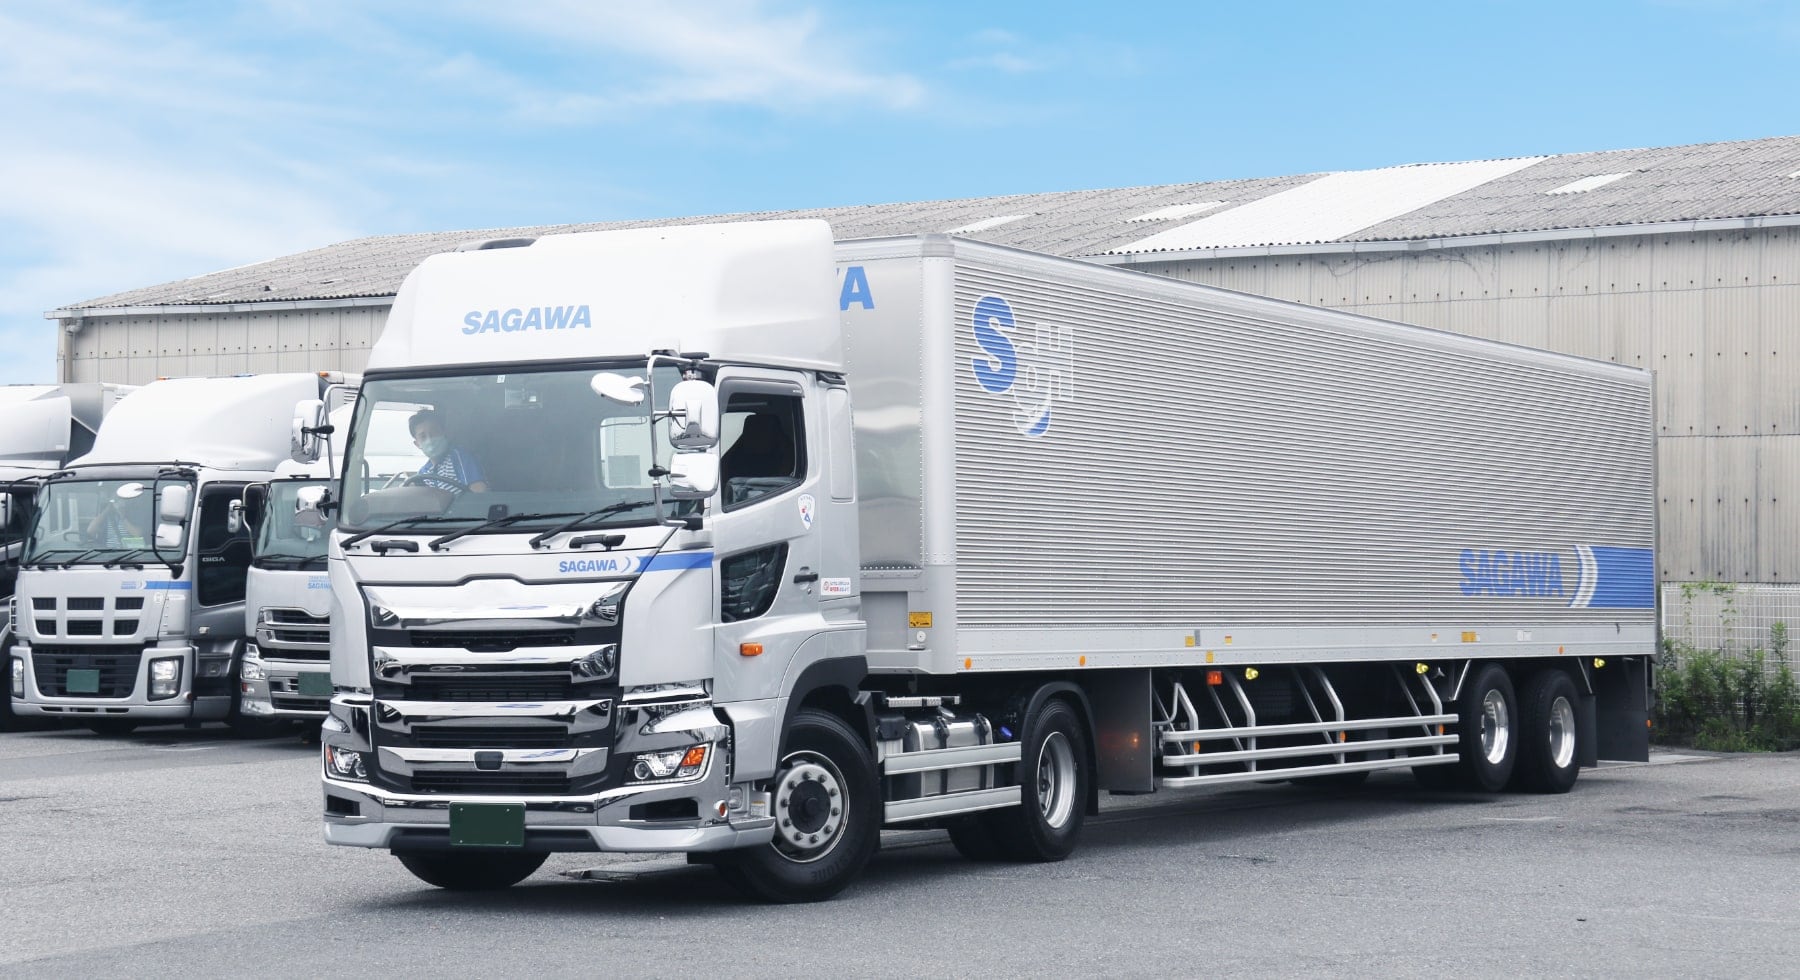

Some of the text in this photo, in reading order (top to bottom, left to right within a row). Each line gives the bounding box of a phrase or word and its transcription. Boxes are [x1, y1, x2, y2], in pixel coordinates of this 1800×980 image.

[836, 266, 875, 311] A
[461, 304, 592, 335] SAGAWA
[559, 559, 618, 573] SAGAWA
[1458, 548, 1564, 597] SAGAWA
